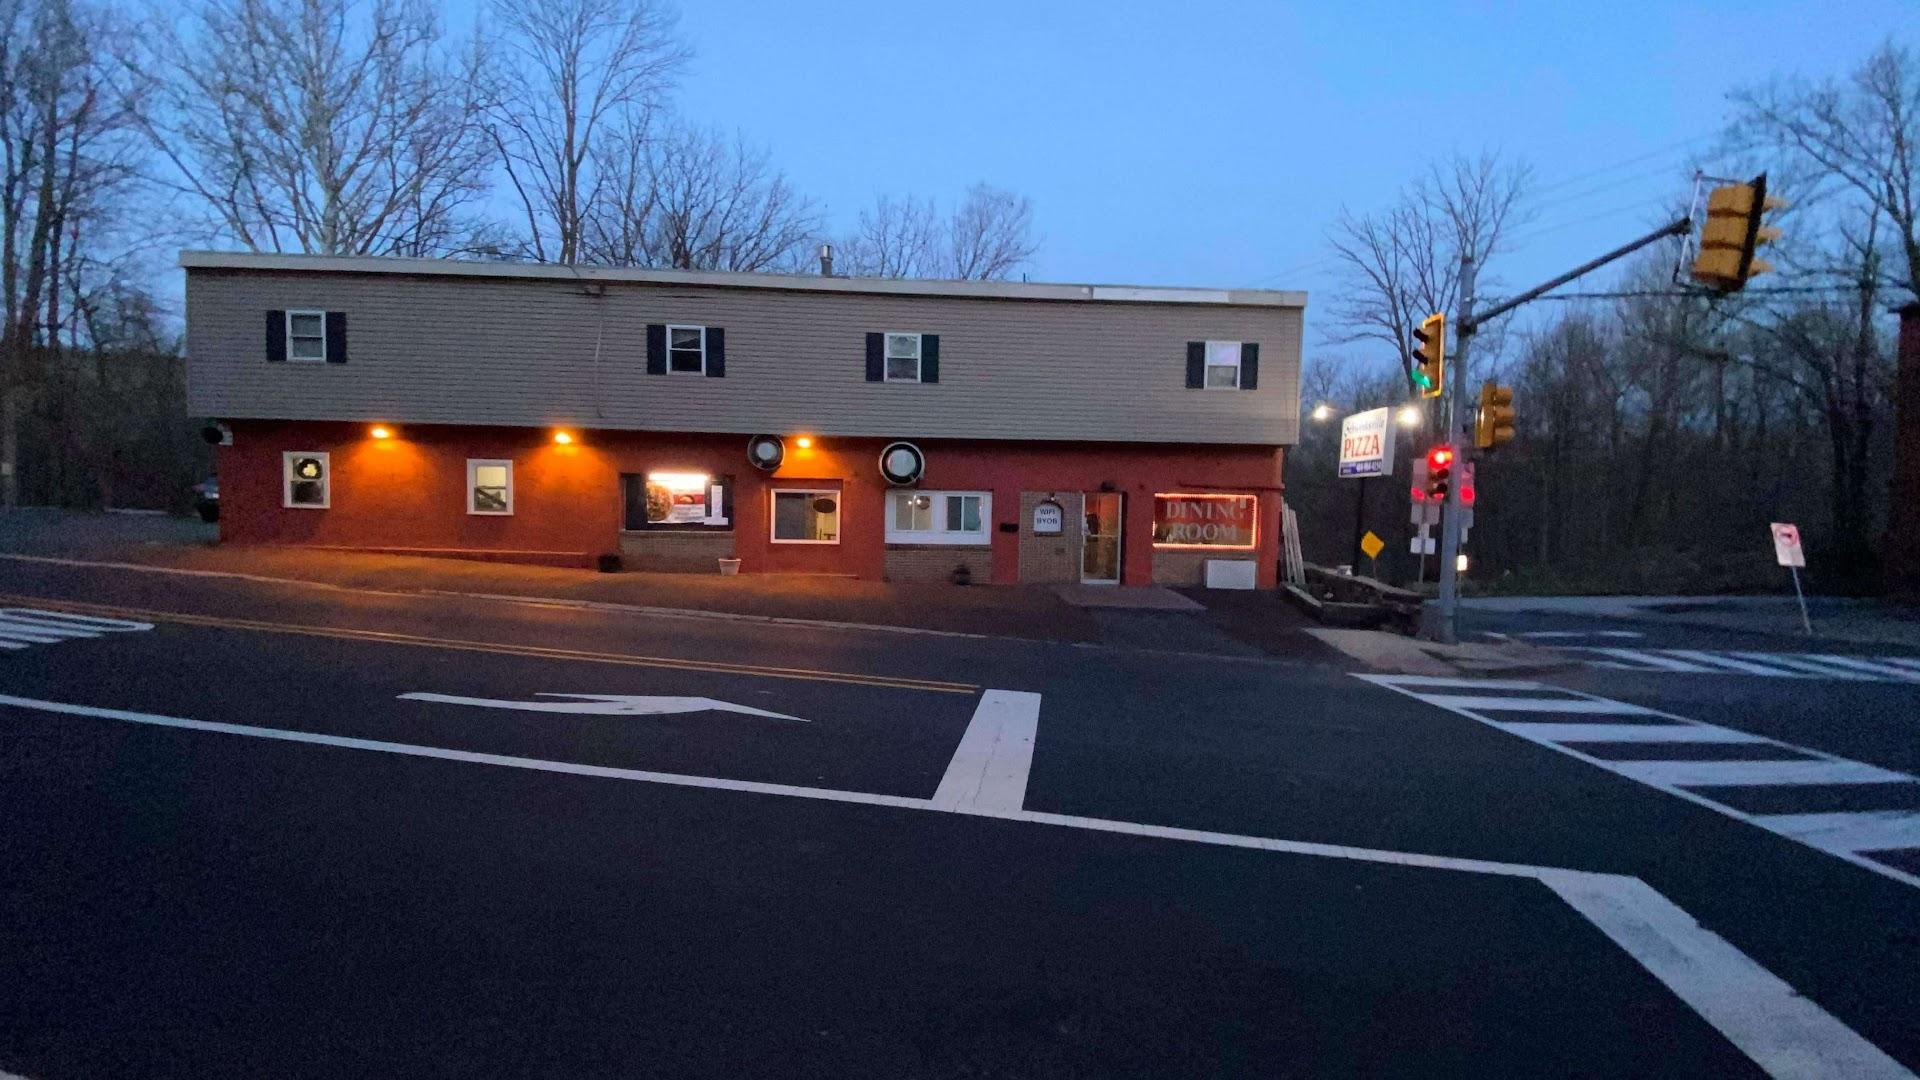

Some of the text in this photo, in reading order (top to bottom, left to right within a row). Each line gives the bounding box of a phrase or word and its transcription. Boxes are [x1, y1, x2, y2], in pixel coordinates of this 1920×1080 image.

[1344, 434, 1380, 458] PIZZA
[1166, 501, 1245, 519] DINING
[1036, 517, 1058, 525] BYOB
[1171, 523, 1238, 541] ROOM
